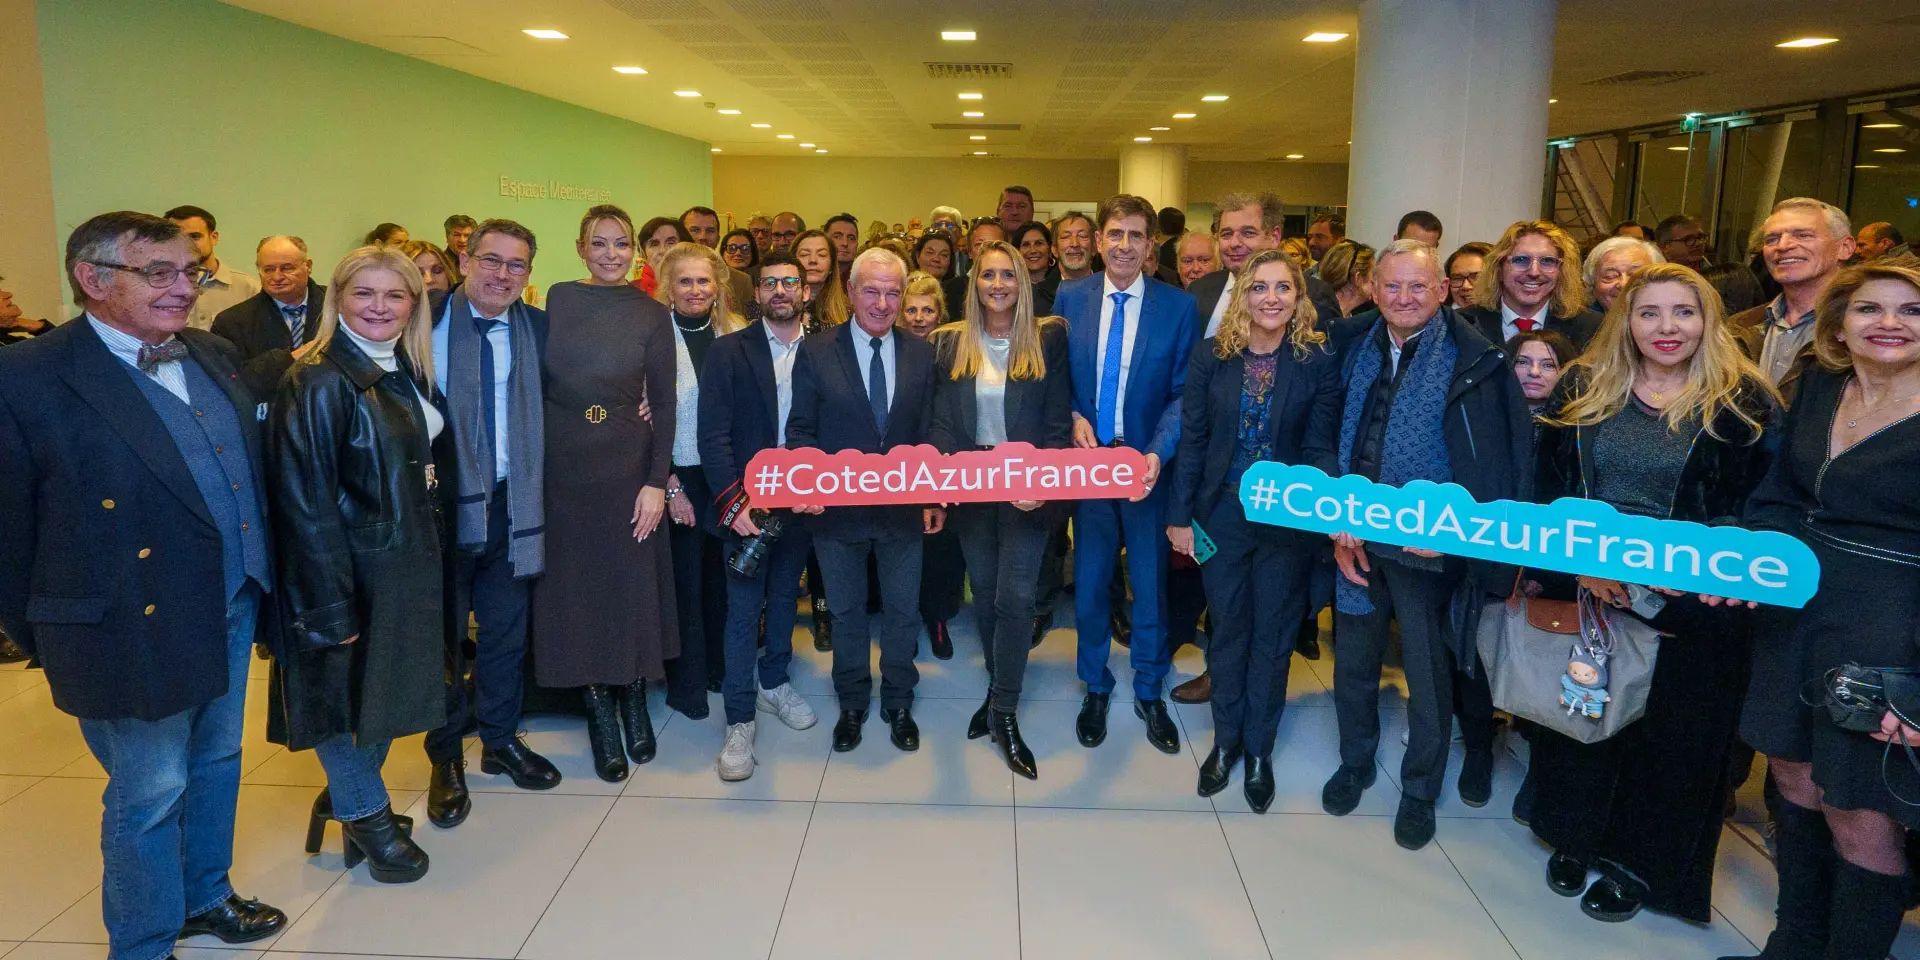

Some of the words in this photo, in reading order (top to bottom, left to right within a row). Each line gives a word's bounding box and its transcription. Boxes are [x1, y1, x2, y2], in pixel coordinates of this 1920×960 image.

[499, 175, 546, 201] Espace
[754, 457, 1134, 496] #CotedAzurFrance
[723, 511, 735, 526] EOS
[731, 502, 741, 513] 6D
[1249, 478, 1789, 588] #CotedAzurFrance
